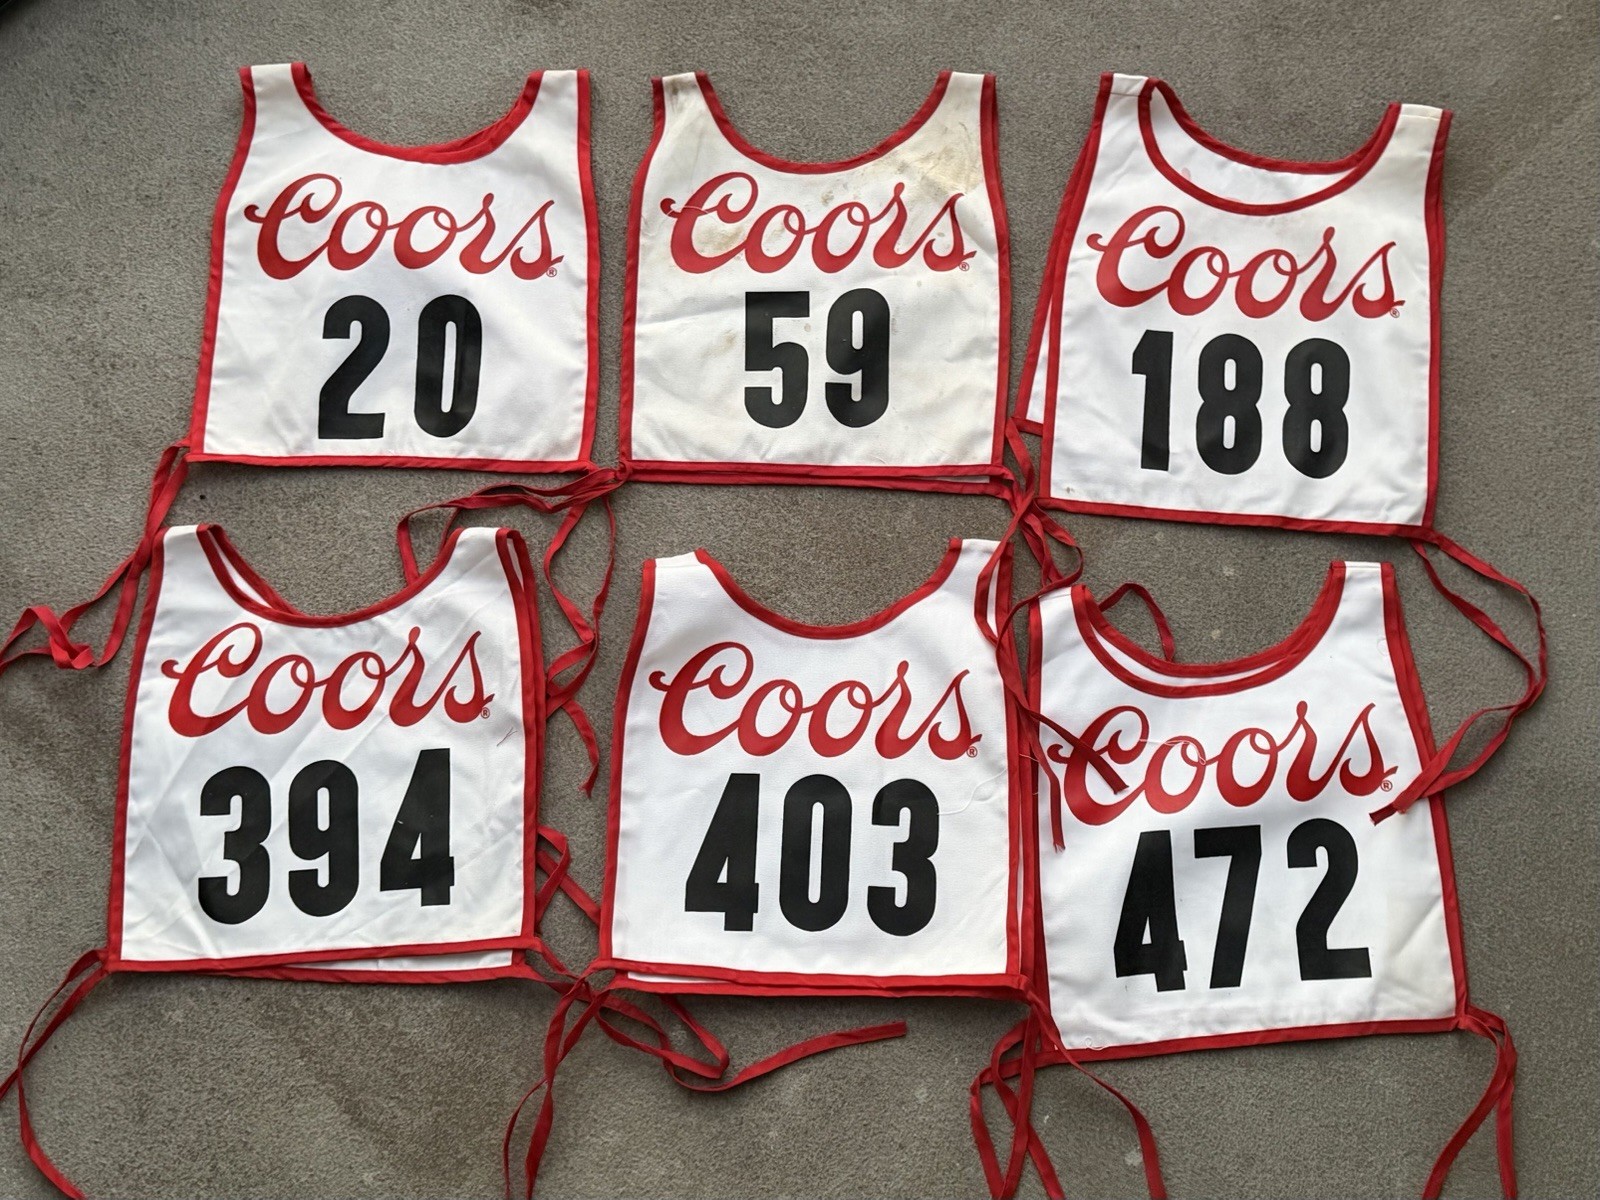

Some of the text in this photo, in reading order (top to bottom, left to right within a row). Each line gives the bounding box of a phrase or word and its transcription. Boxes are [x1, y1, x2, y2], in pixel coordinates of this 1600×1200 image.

[244, 173, 563, 280] Coors
[660, 171, 976, 274] Coors
[1087, 205, 1404, 319] Coors
[318, 294, 483, 440] 20
[744, 288, 891, 429] 59
[1131, 329, 1351, 479] 188
[162, 622, 495, 737] Coors
[649, 641, 982, 759] Coors
[1047, 700, 1398, 825] Coors
[197, 747, 455, 925] 394
[684, 772, 940, 937] 403
[1113, 817, 1372, 993] 472
